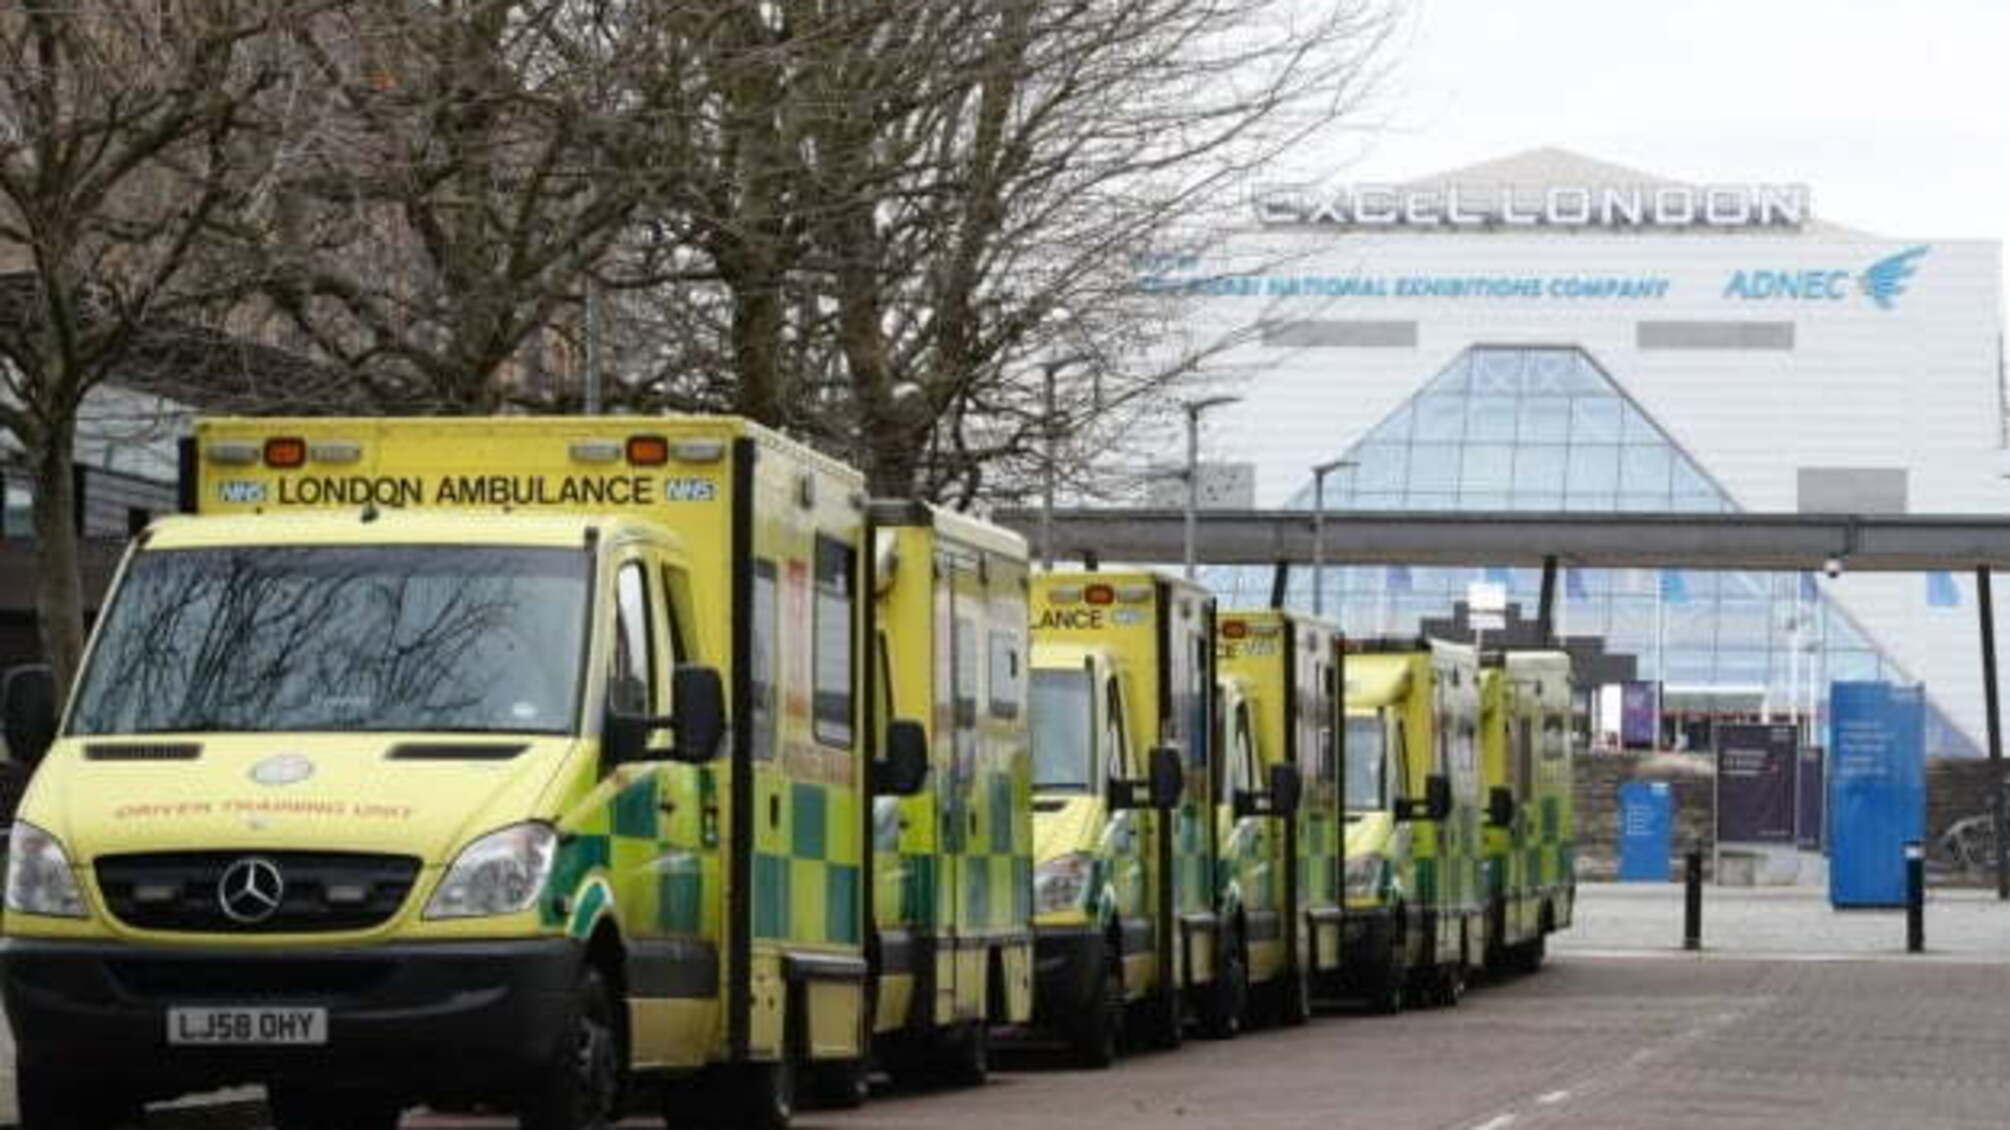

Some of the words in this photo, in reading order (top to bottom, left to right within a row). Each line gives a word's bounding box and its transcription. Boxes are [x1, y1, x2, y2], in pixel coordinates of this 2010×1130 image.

[1502, 184, 1807, 226] LONDON
[1266, 277, 1389, 298] NATIONAL
[1393, 277, 1544, 298] EXHIBITIONS
[1548, 277, 1670, 299] COMPANY
[1723, 269, 1851, 300] ADNEC
[277, 476, 424, 506] LONDON
[436, 475, 654, 506] AMBULANCE
[178, 1012, 252, 1040] LJ58
